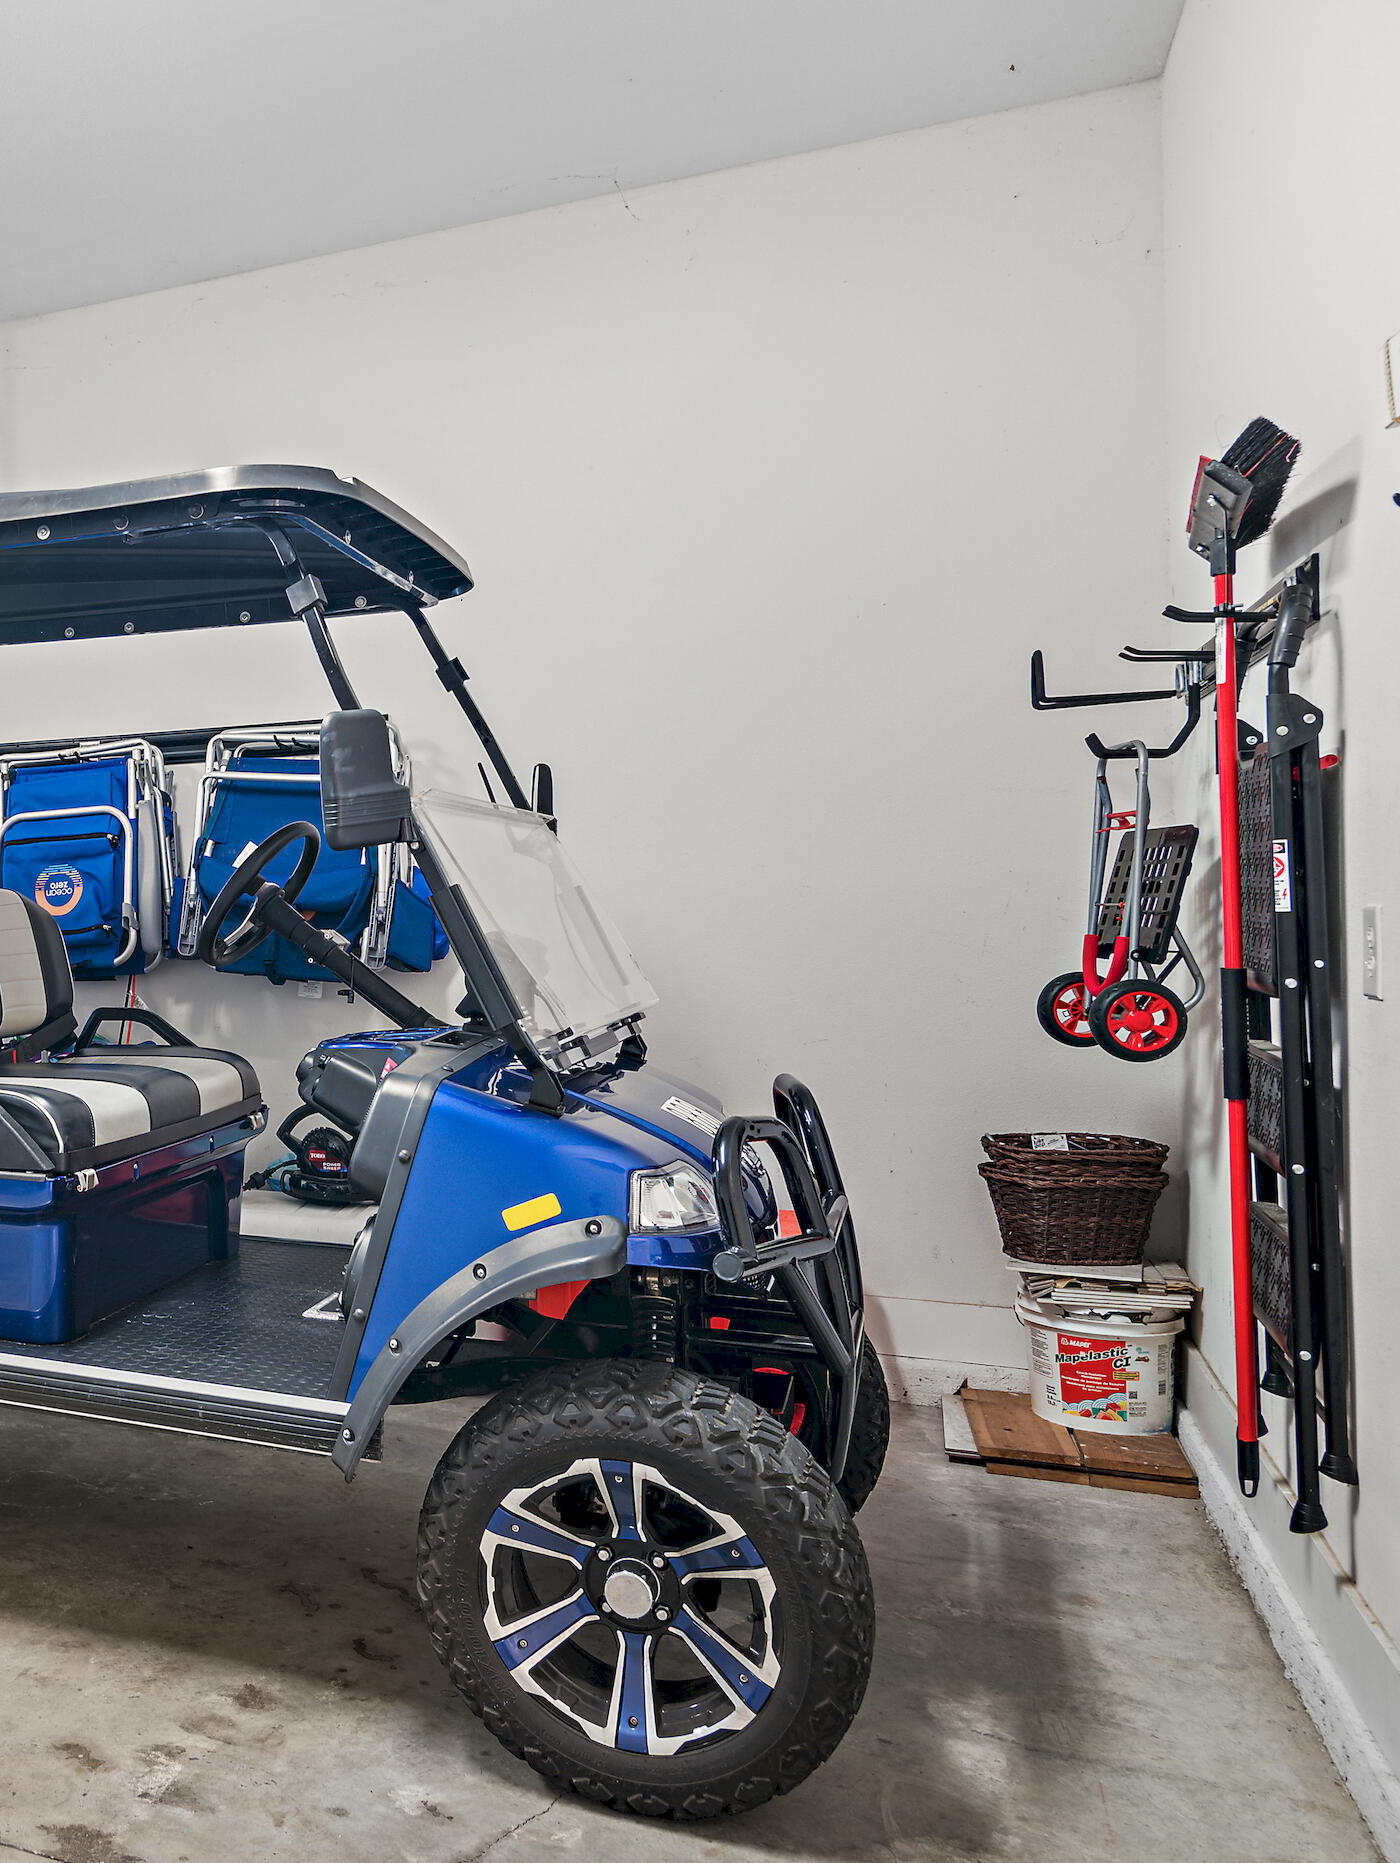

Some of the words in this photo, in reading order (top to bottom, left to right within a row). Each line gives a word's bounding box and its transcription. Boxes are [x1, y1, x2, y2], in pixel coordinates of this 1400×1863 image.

[50, 881, 68, 889] zero
[46, 888, 73, 896] ocean
[1055, 1347, 1128, 1364] Mapelastic
[1113, 1356, 1132, 1369] CI
